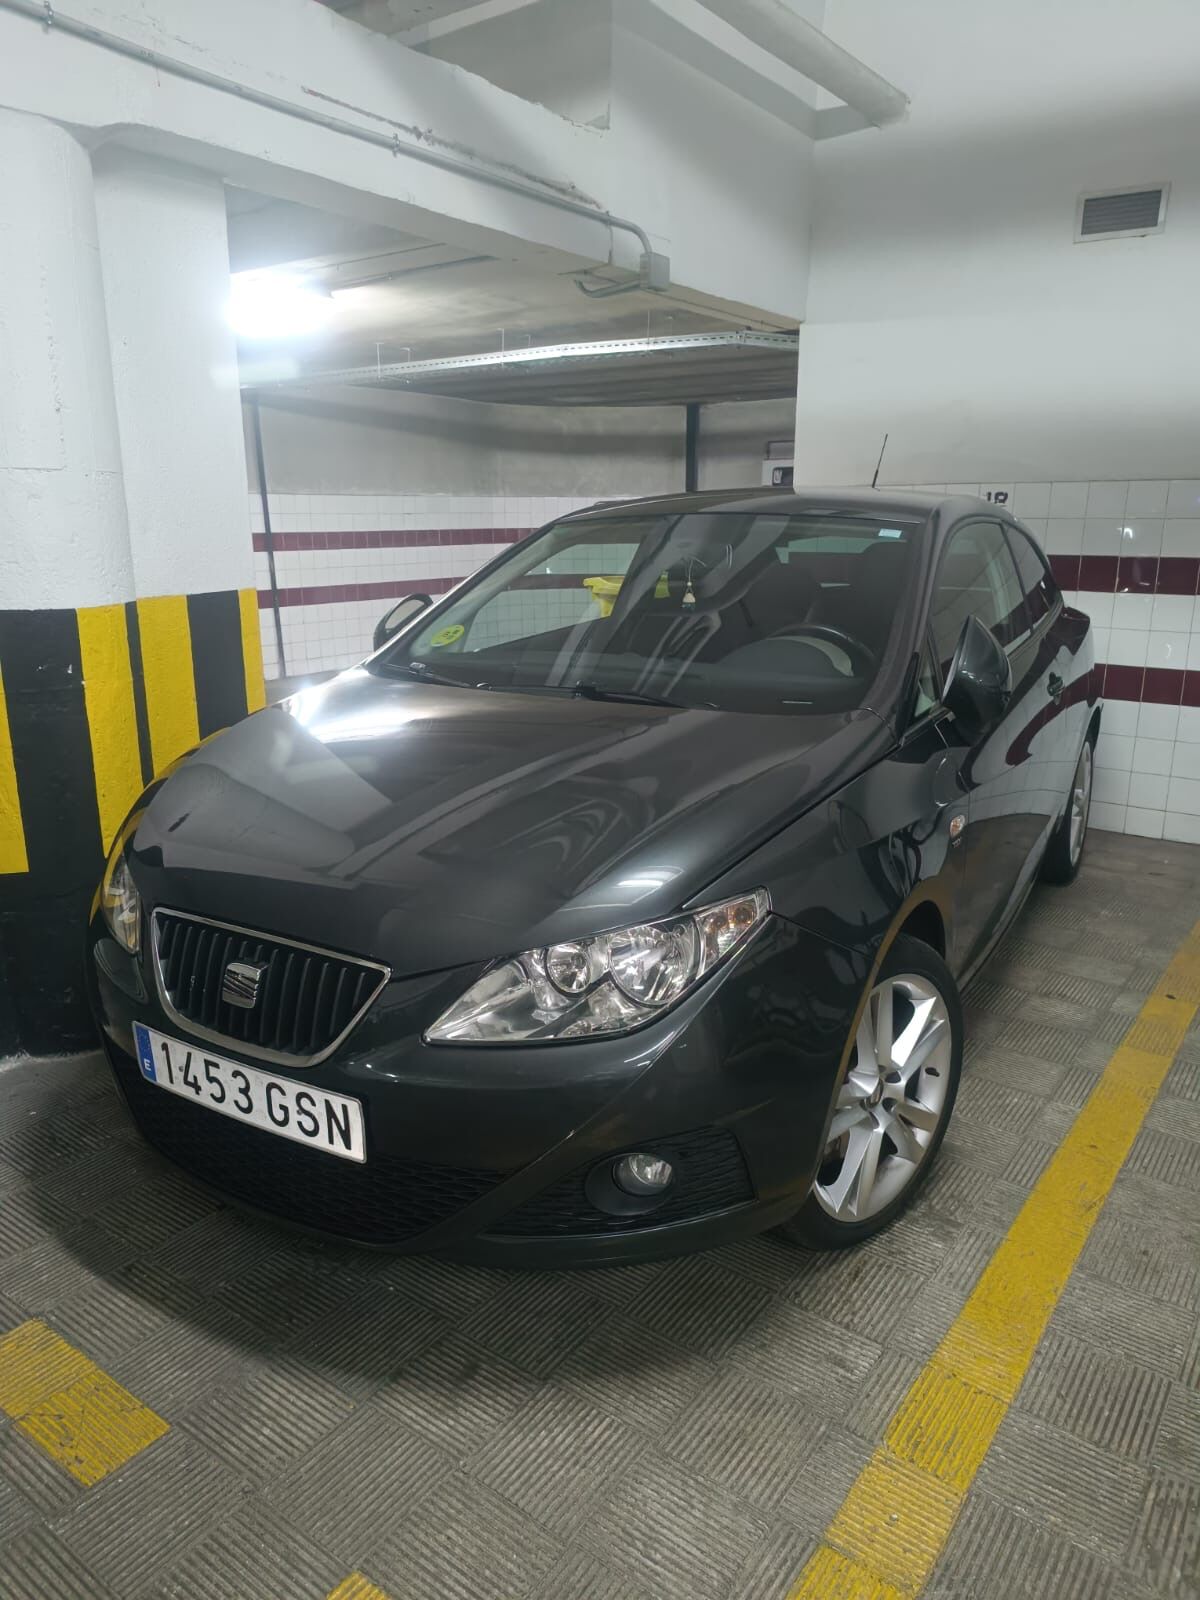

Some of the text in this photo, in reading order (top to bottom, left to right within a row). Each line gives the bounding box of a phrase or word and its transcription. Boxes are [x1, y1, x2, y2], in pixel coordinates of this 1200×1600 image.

[144, 1059, 152, 1071] E
[161, 1042, 352, 1151] 1453 GSN
